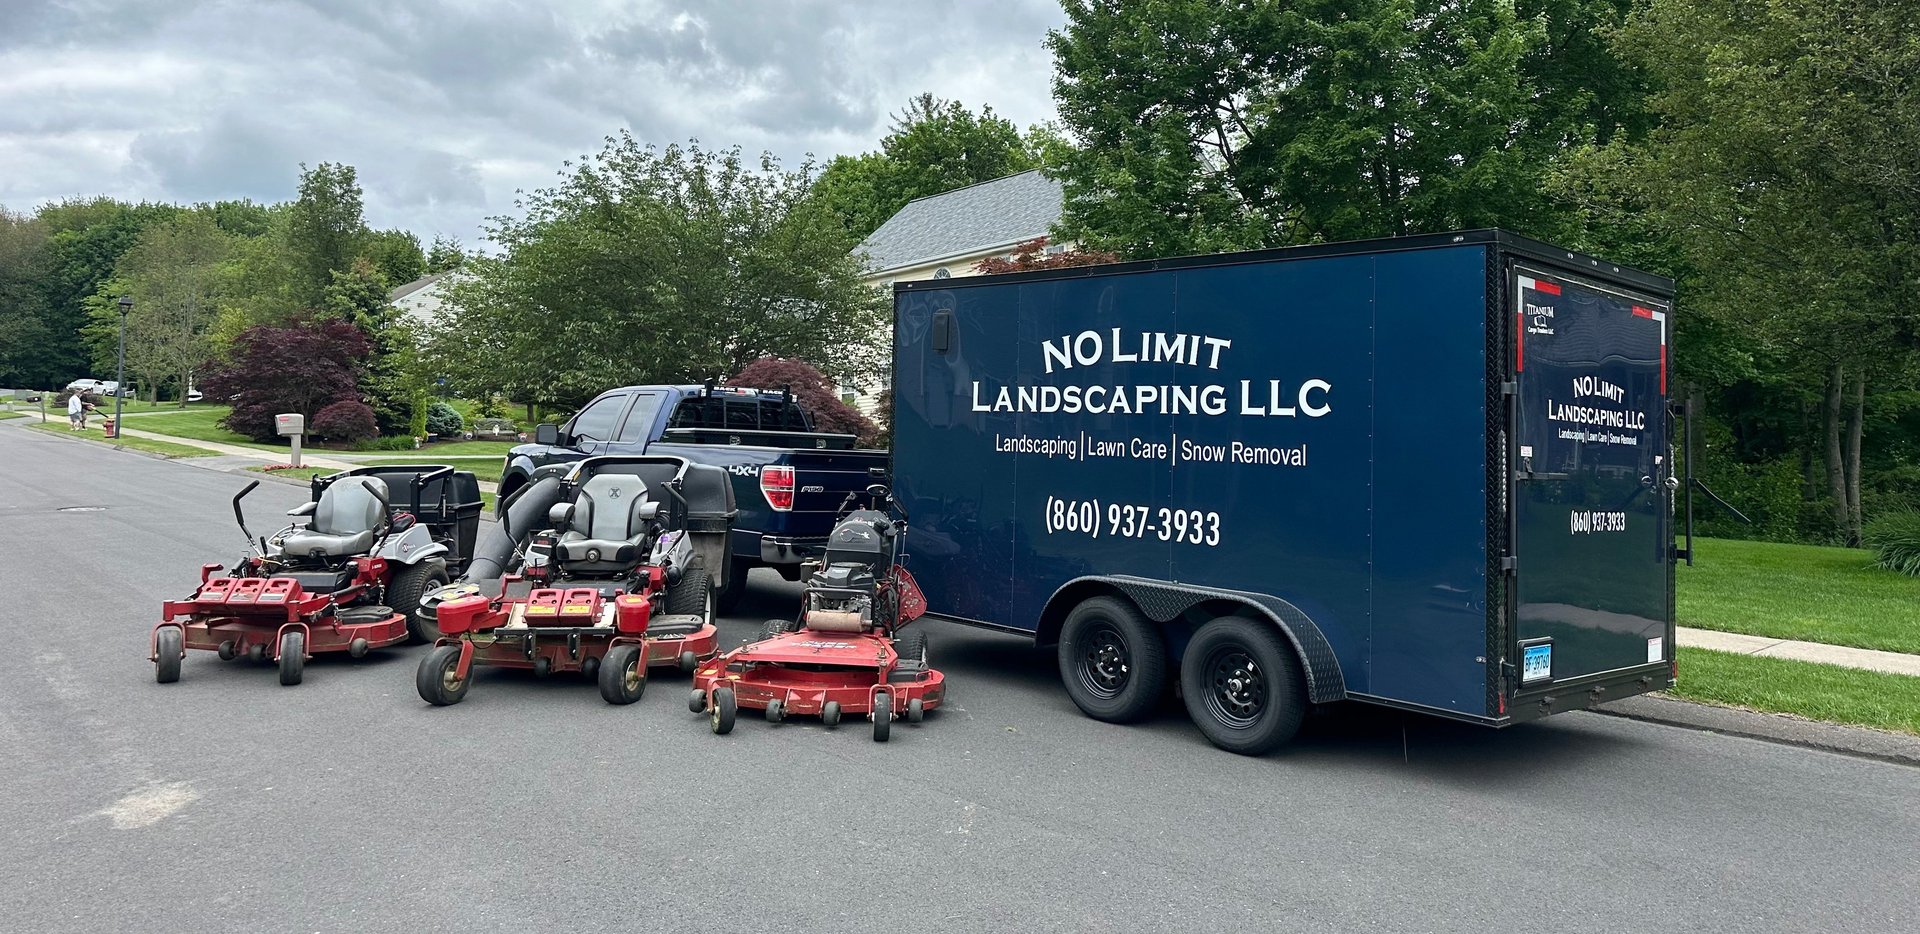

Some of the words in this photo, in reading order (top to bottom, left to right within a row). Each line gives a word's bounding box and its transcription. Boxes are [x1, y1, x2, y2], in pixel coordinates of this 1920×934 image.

[1526, 303, 1554, 318] TITANIUM
[1041, 330, 1103, 374] NO
[1111, 327, 1232, 370] LIMIT
[971, 381, 1227, 416] LANDSCAPING
[1239, 378, 1333, 417] LLC
[1573, 376, 1593, 399] NO
[1594, 376, 1625, 404] LIMIT
[1548, 399, 1624, 428] LANDSCAPING
[1625, 410, 1645, 430] LLC
[995, 433, 1076, 460] Landscaping
[1088, 435, 1125, 458] Lawn
[1130, 437, 1167, 460] Care
[1180, 439, 1226, 463] Snow
[1231, 441, 1307, 466] Removal
[1558, 427, 1585, 443] Landscaping
[1597, 431, 1608, 442] Care
[1609, 432, 1621, 444] Snow
[1620, 433, 1637, 446] Removal
[1045, 494, 1101, 539] (860)
[1107, 503, 1221, 546] 937-3933
[1570, 509, 1591, 535] (860)
[1592, 511, 1625, 532] 937-3933
